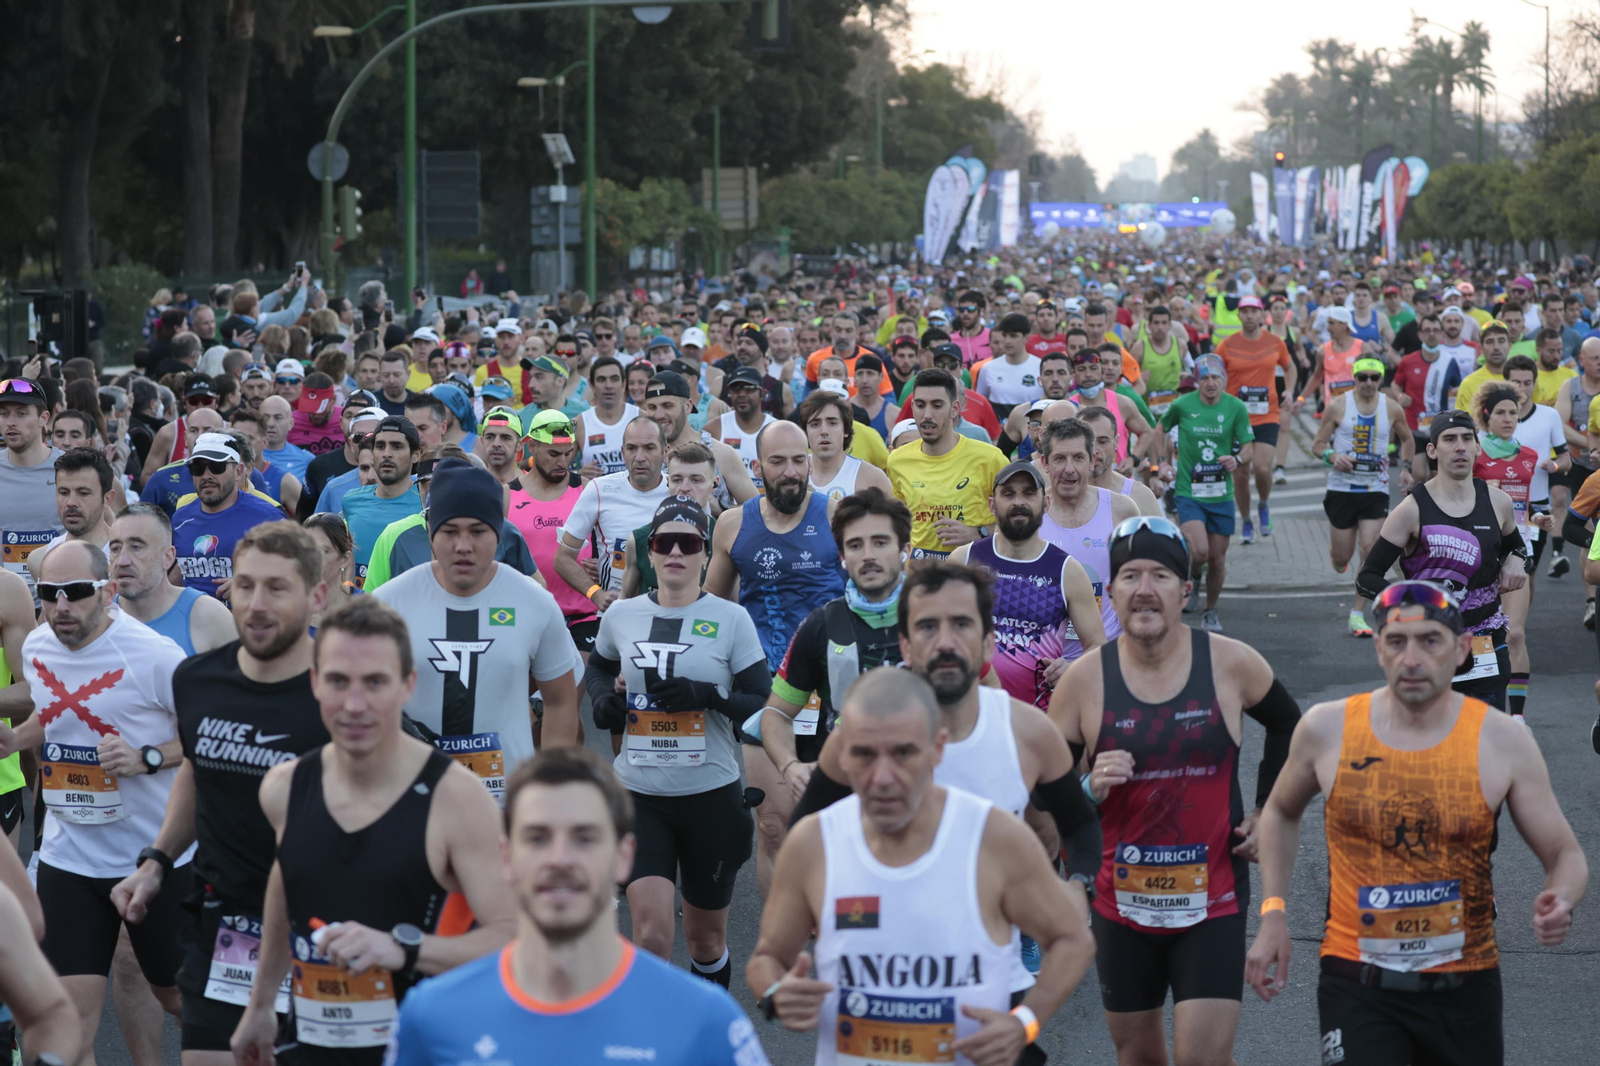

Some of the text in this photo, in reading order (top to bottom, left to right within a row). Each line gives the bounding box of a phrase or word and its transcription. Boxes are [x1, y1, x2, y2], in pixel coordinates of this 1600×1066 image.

[1353, 425, 1370, 453] CHE
[20, 534, 53, 542] ZURICH
[1426, 534, 1479, 556] ARRASATE
[1429, 546, 1476, 566] RUNNERS
[196, 716, 254, 743] NIKE
[651, 721, 678, 732] 5503
[442, 737, 491, 751] ZURICH
[652, 740, 678, 748] NUBIA
[62, 748, 99, 762] ZURICH
[66, 773, 90, 786] 4803
[66, 793, 95, 804] BENITO
[1144, 850, 1196, 863] ZURICH
[1144, 877, 1176, 890] 4422
[1132, 895, 1190, 908] ESPARTANO
[1394, 919, 1430, 933] 4212
[1400, 940, 1426, 952] KICO
[222, 968, 252, 982] JUAN
[838, 954, 983, 989] ANGOLA
[322, 1006, 353, 1019] ANTO
[870, 1000, 942, 1019] ZURICH
[872, 1036, 913, 1056] 5116
